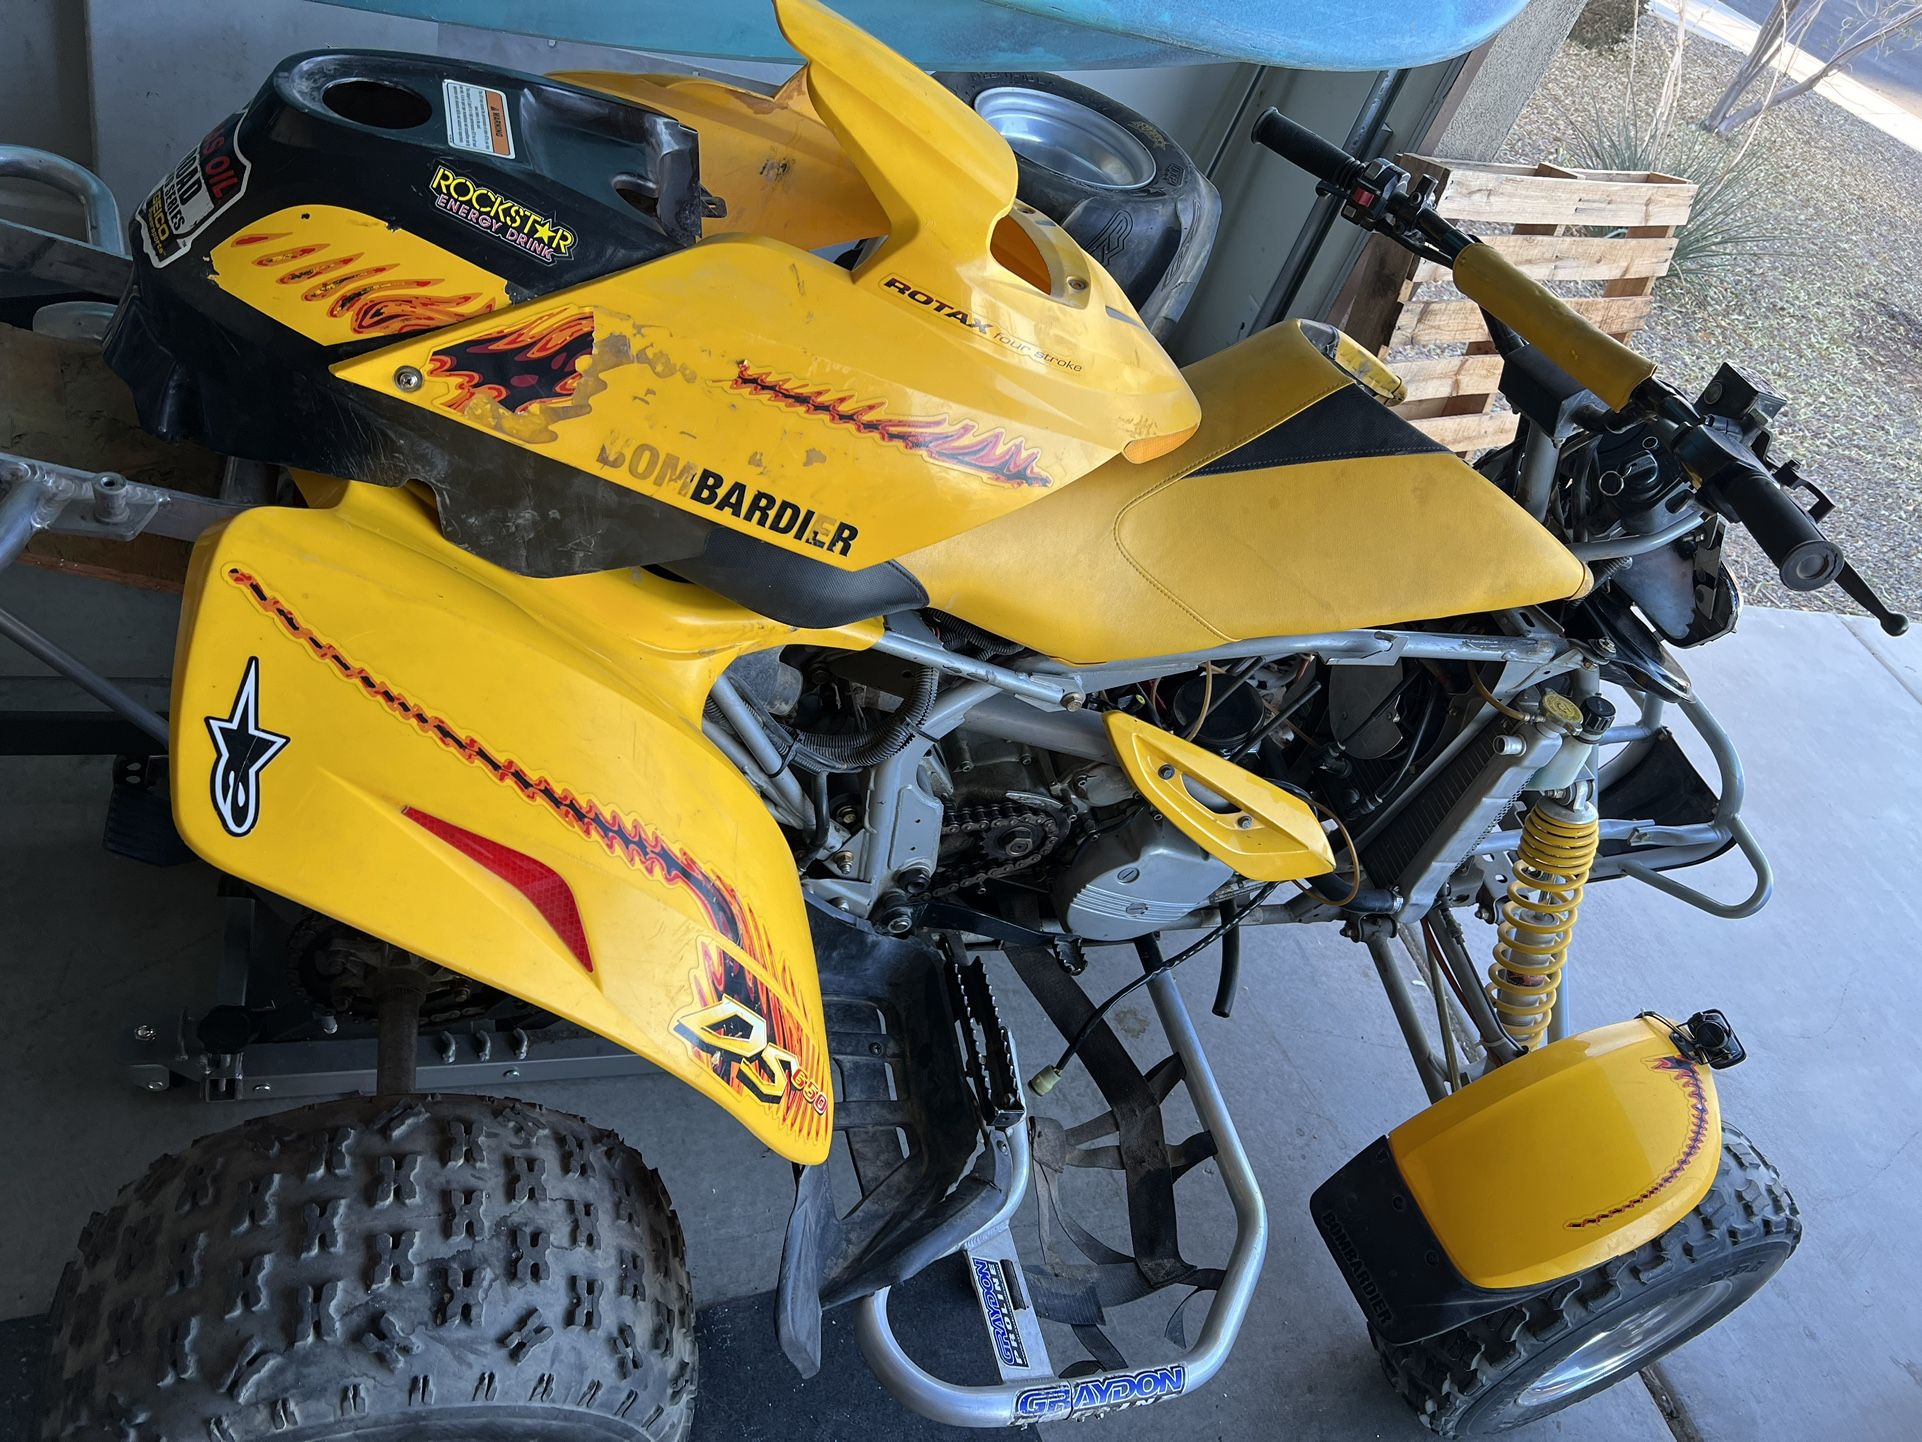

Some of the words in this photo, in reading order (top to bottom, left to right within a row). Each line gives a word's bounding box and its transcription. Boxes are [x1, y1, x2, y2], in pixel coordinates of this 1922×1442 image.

[152, 191, 170, 241] GEICO
[205, 155, 239, 199] OIL
[437, 194, 503, 233] ENERGY
[505, 228, 554, 259] DRINK
[883, 277, 993, 334] ROTAX
[993, 332, 1031, 351] four
[1033, 349, 1083, 373] stroke
[673, 993, 799, 1104] DS
[791, 1068, 828, 1114] 650
[1322, 1210, 1394, 1325] BOMBARDIER
[975, 1259, 1014, 1365] GRAYDON
[1017, 1365, 1186, 1416] GRAYDON
